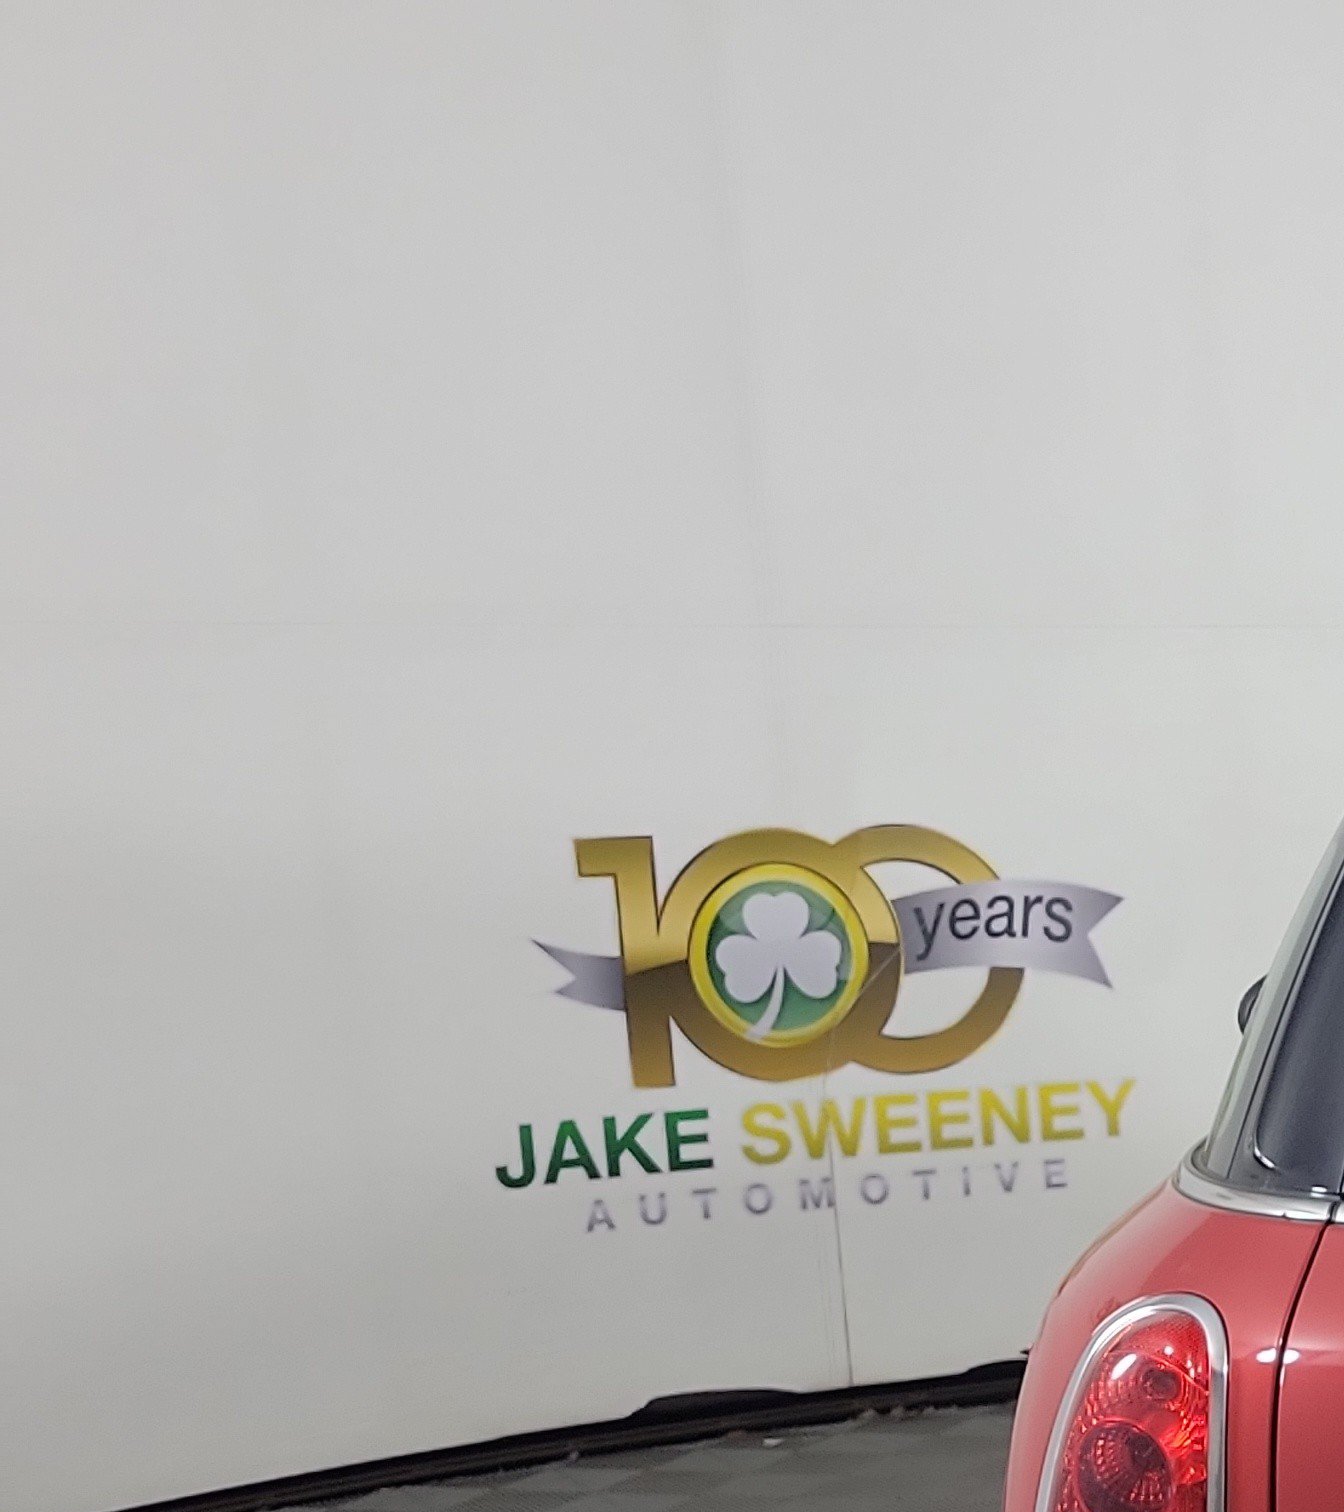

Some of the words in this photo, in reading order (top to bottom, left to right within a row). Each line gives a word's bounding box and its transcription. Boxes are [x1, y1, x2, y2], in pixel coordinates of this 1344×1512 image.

[573, 824, 1025, 1088] 100
[912, 894, 1074, 960] years
[495, 1108, 714, 1188] JAKE
[741, 1079, 1136, 1166] SWEENEY
[585, 1158, 1069, 1233] AUTOMOTIVE
